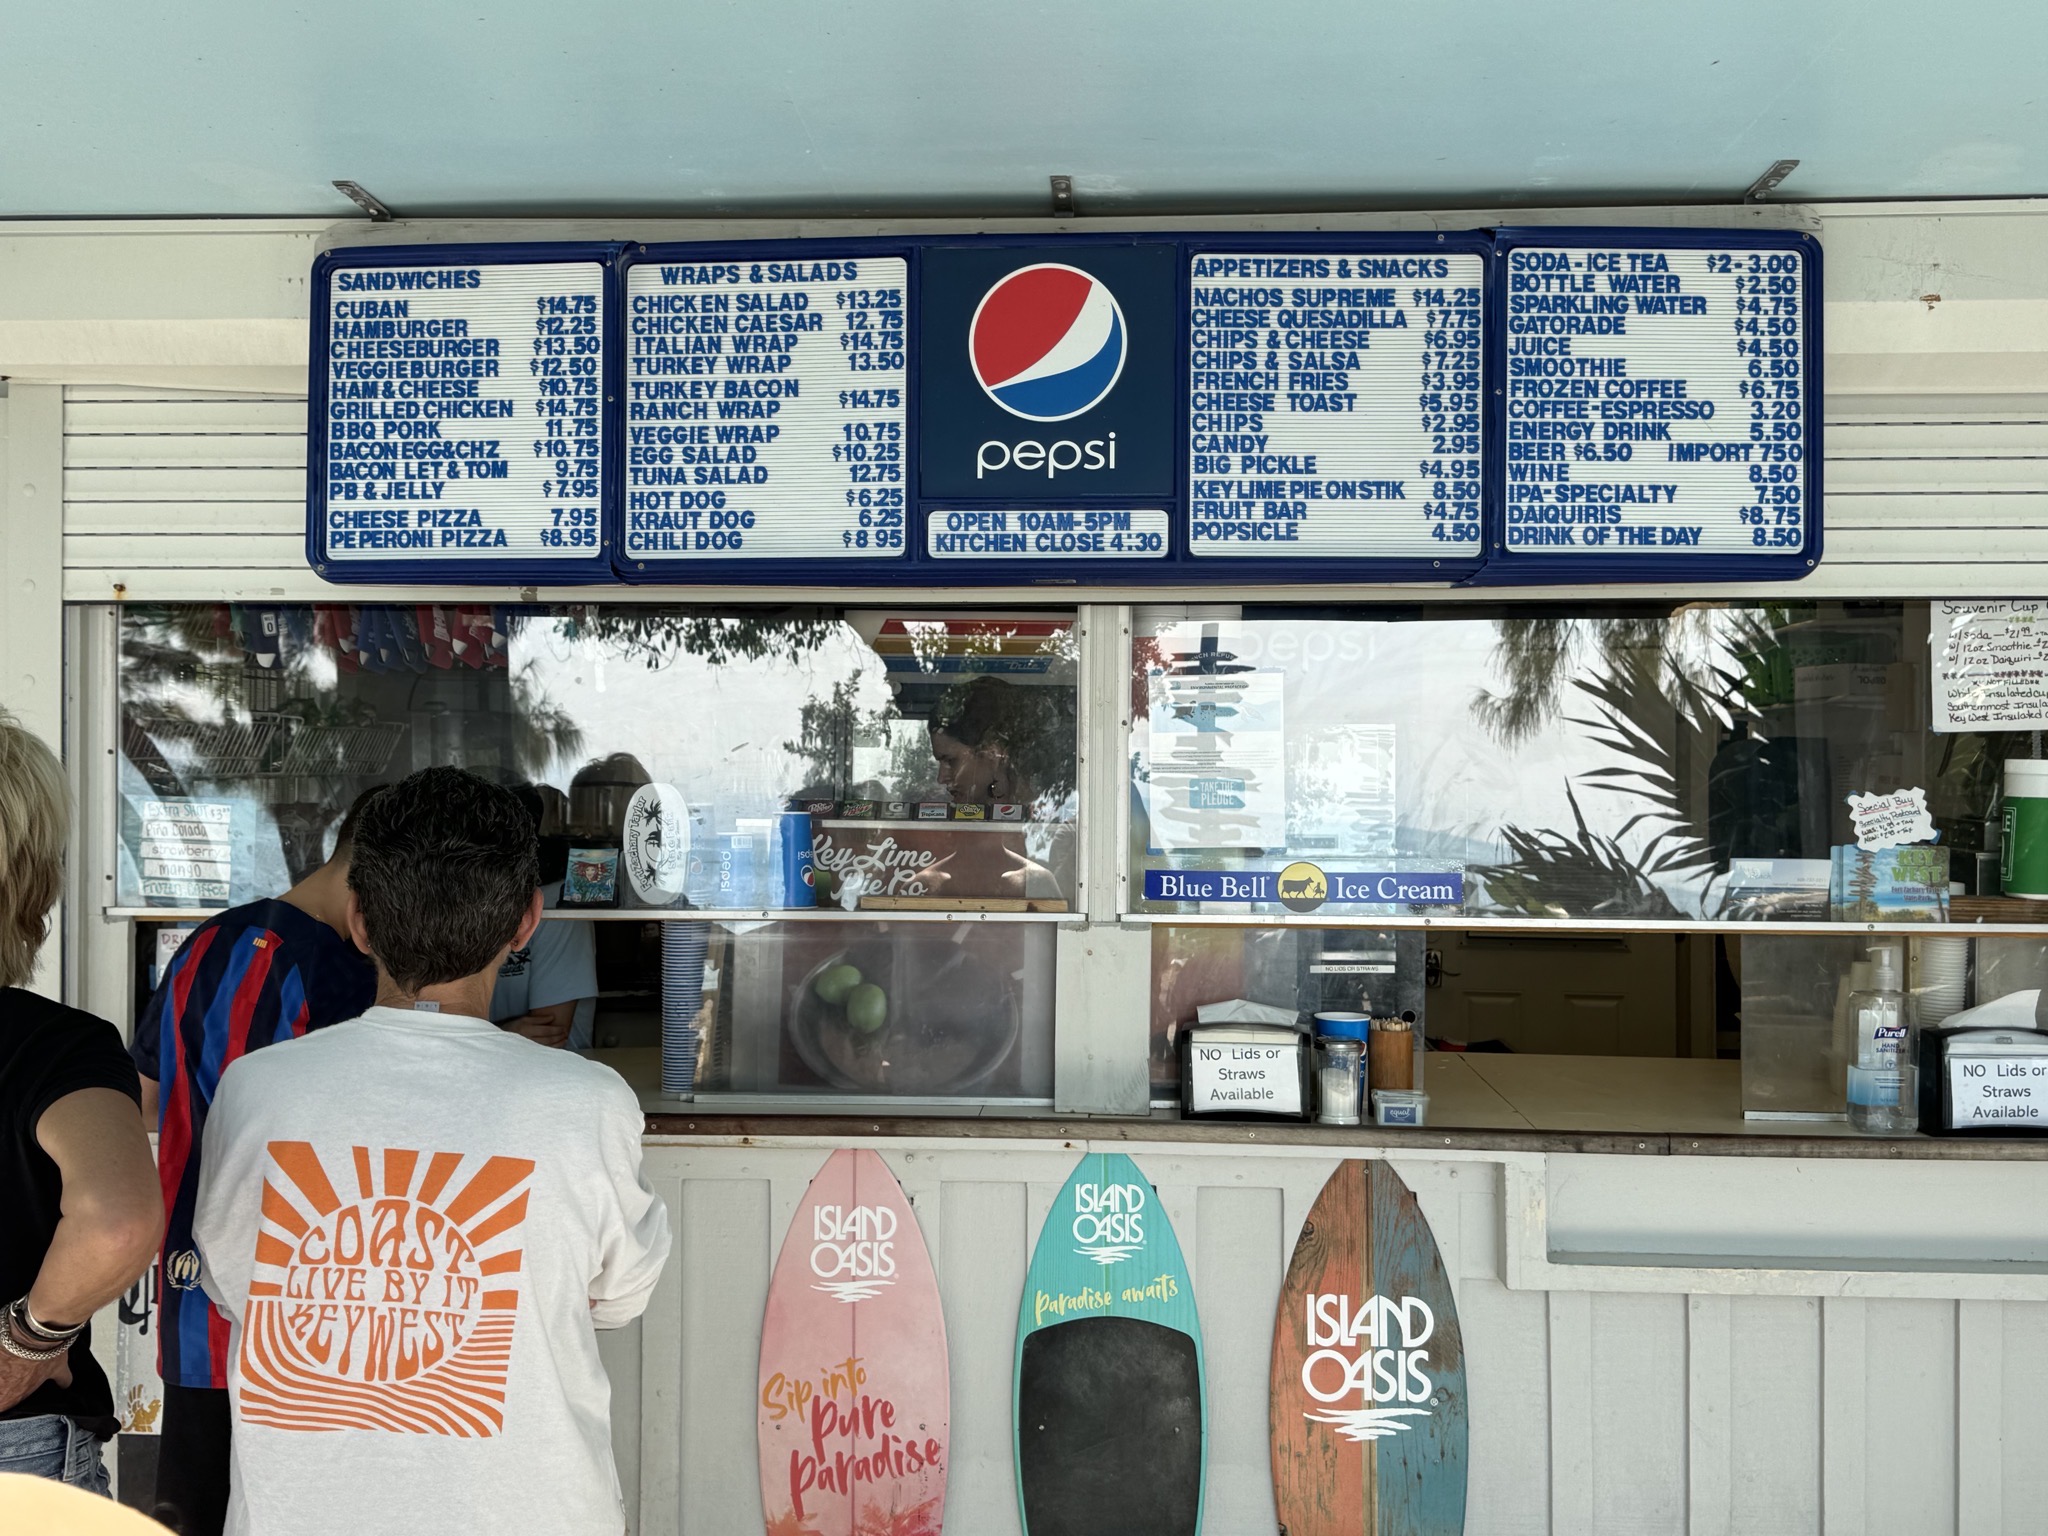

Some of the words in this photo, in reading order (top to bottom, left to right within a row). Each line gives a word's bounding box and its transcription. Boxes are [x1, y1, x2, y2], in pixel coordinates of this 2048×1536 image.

[661, 266, 739, 283] WRAPS
[749, 265, 762, 282] &
[768, 263, 857, 281] SALADS
[1194, 259, 1329, 277] APPETIZERS
[1338, 260, 1351, 278] &
[1358, 260, 1447, 277] SNACKS
[339, 271, 480, 289] SANDWICHES
[1512, 274, 1594, 292] BOTTLE
[1608, 275, 1679, 293] WATER
[1736, 276, 1796, 294] $2.50
[336, 301, 408, 318] CUBAN
[539, 296, 596, 313] $14.75
[633, 295, 728, 313] CHICKEN
[736, 294, 807, 311] SALAD
[837, 290, 901, 311] $13.25
[1194, 288, 1283, 306] NACHOS
[1292, 289, 1394, 307] SUPREME
[1413, 289, 1480, 306] $14.25
[334, 317, 466, 338] HAMBURGER
[537, 316, 596, 337] $12.25
[1192, 309, 1269, 328] CHEESE
[1277, 310, 1407, 331] QUESADILLA
[1428, 309, 1481, 328] $7.75
[1509, 316, 1624, 334] GATORADE
[1735, 317, 1796, 335] $4.50
[330, 337, 498, 358] CHEESEBURGER
[534, 336, 600, 354] $13.50
[636, 336, 721, 357] ITALIAN
[733, 334, 797, 352] WRAP
[841, 331, 903, 349] $14.75
[1510, 358, 1624, 376] SMOOTHIE
[1748, 359, 1798, 378] 6.50
[1193, 372, 1278, 390] FRENCH
[1289, 372, 1348, 391] FRIES
[1422, 372, 1479, 390] $3.95
[1511, 379, 1599, 398] FROZEN
[1605, 380, 1684, 398] COFFEE
[1740, 380, 1799, 398] $6.75
[330, 401, 420, 419] GRILLED
[423, 400, 512, 417] CHICKEN
[537, 398, 597, 419] $14.75
[332, 422, 375, 440] BBQ
[384, 421, 440, 439] PORK
[547, 418, 597, 436] 11.75
[631, 426, 708, 447] VEGGIE
[715, 425, 779, 443] WRAP
[843, 422, 900, 440] 10.75
[1509, 421, 1594, 440] ENERGY
[1604, 422, 1670, 440] DRINK
[1750, 422, 1801, 441] 5.50
[977, 431, 1116, 479] pepsi
[1509, 463, 1568, 482] WINE
[1749, 464, 1797, 483] 8.50
[1193, 501, 1253, 519] FRUIT
[1264, 501, 1306, 520] BAR
[1424, 499, 1478, 520] $4.75
[1508, 505, 1621, 524] DAIQUIRIS
[1740, 506, 1800, 525] $8.75
[947, 513, 1006, 531] OPEN
[1193, 522, 1296, 540] POPSICLE
[1432, 523, 1480, 541] 4.50
[330, 530, 433, 548] PEPERONI
[442, 529, 507, 547] PIZZA
[541, 528, 596, 546] $8.95
[936, 534, 1026, 552] KITCHEN
[1035, 533, 1104, 551] CLOSE
[1941, 600, 2006, 614] Souvenir
[2011, 600, 2039, 613] Cup
[1987, 641, 2032, 651] Smoothie
[1949, 713, 1966, 724] Key
[1969, 713, 1990, 721] West
[1992, 709, 2042, 720] Insulated
[632, 796, 646, 827] Taylor
[1858, 798, 1891, 814] Special
[1893, 797, 1914, 808] Buy
[627, 827, 641, 877] Zachary
[813, 834, 856, 871] Key
[853, 837, 936, 872] Lime
[1898, 850, 1936, 866] KEY
[160, 864, 201, 877] mango
[633, 864, 652, 892] Fort
[721, 850, 732, 892] pepsi
[1891, 867, 1942, 883] WEST
[831, 866, 886, 900] Pie
[1160, 876, 1212, 898] Blue
[1220, 877, 1267, 898] Bell
[1335, 877, 1369, 899] Ice
[1377, 877, 1453, 900] Cream
[1878, 1028, 1905, 1037] Purell
[1200, 1049, 1222, 1061] NO
[1232, 1048, 1260, 1060] Lids
[1266, 1049, 1280, 1059] or
[1218, 1068, 1265, 1080] Straws
[1963, 1065, 1986, 1077] NO
[1997, 1064, 2026, 1076] Lids
[2032, 1067, 2047, 1076] or
[1210, 1087, 1274, 1100] Available
[1983, 1086, 2031, 1098] Straws
[1390, 1108, 1410, 1117] equal
[1972, 1106, 2039, 1118] Available
[1075, 1183, 1145, 1213] ISLAND
[813, 1205, 897, 1241] ISLAND
[1072, 1213, 1144, 1244] OASIS
[299, 1199, 476, 1274] COAST
[810, 1242, 895, 1278] OASIS
[286, 1266, 366, 1301] LIVE
[382, 1270, 429, 1304] BY
[442, 1276, 479, 1310] IT
[1121, 1274, 1179, 1303] awaits
[1306, 1293, 1434, 1347] ISLAND
[1301, 1349, 1433, 1402] OASIS
[762, 1372, 813, 1422] Sip
[821, 1357, 867, 1401] into
